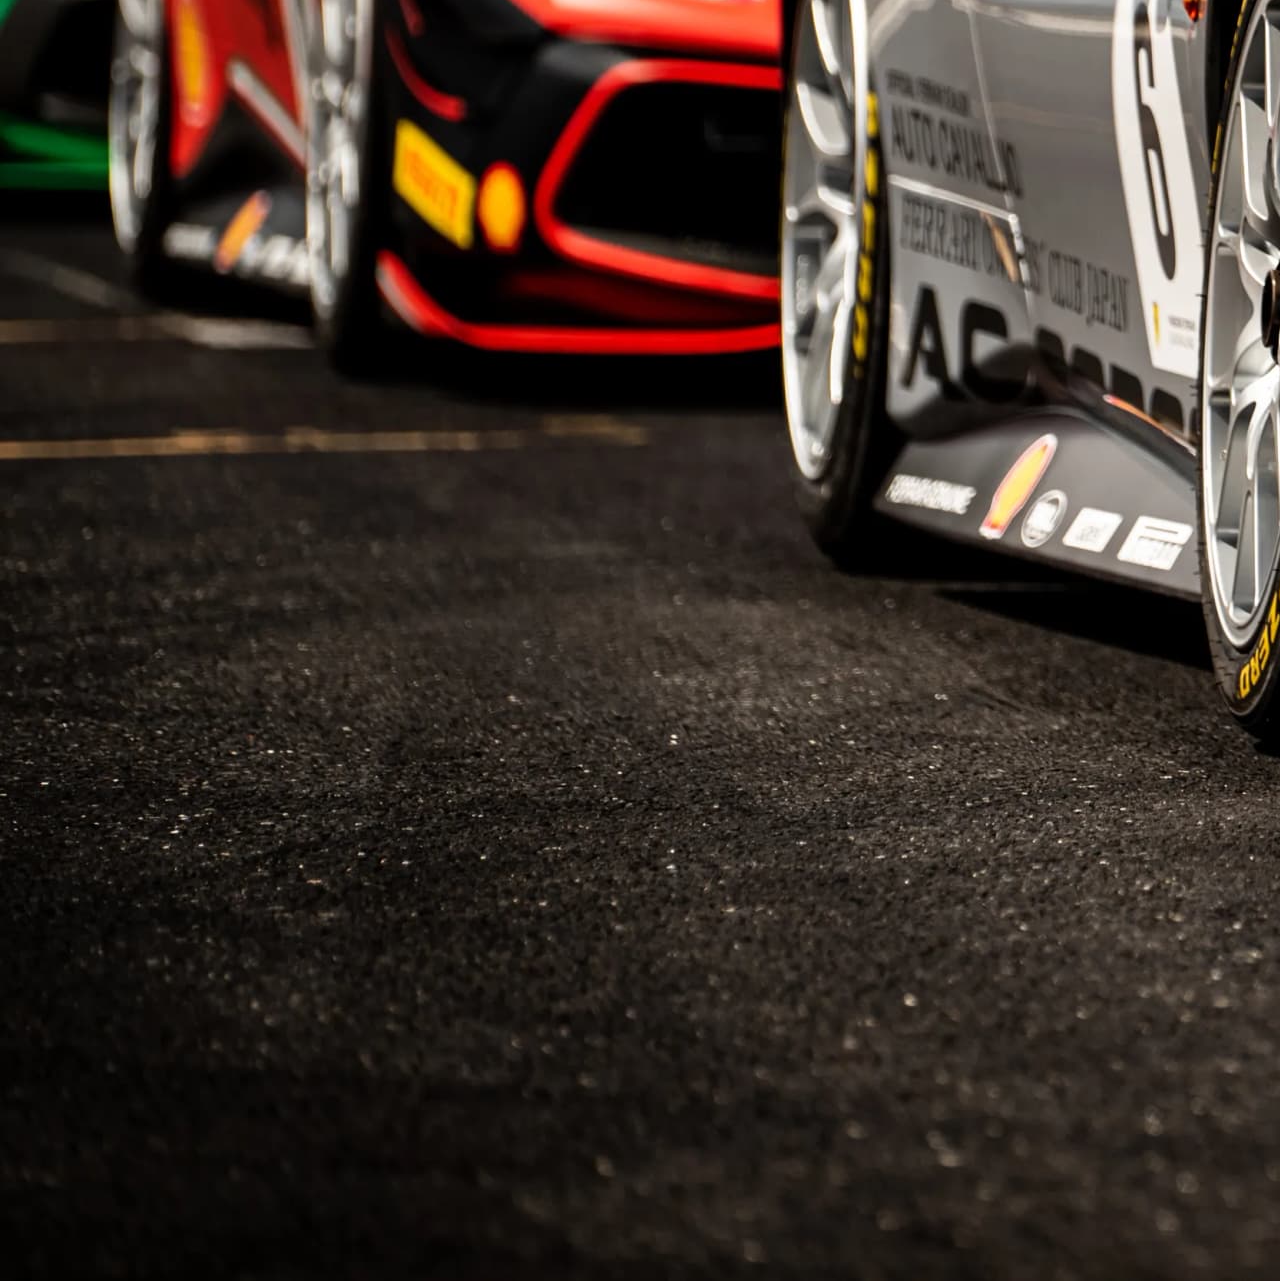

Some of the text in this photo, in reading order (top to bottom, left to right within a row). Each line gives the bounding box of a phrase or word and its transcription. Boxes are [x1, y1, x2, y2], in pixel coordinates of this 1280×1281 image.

[1132, 1, 1178, 281] 6
[1085, 262, 1130, 333] JAPAN
[1239, 591, 1280, 699] ZERO
